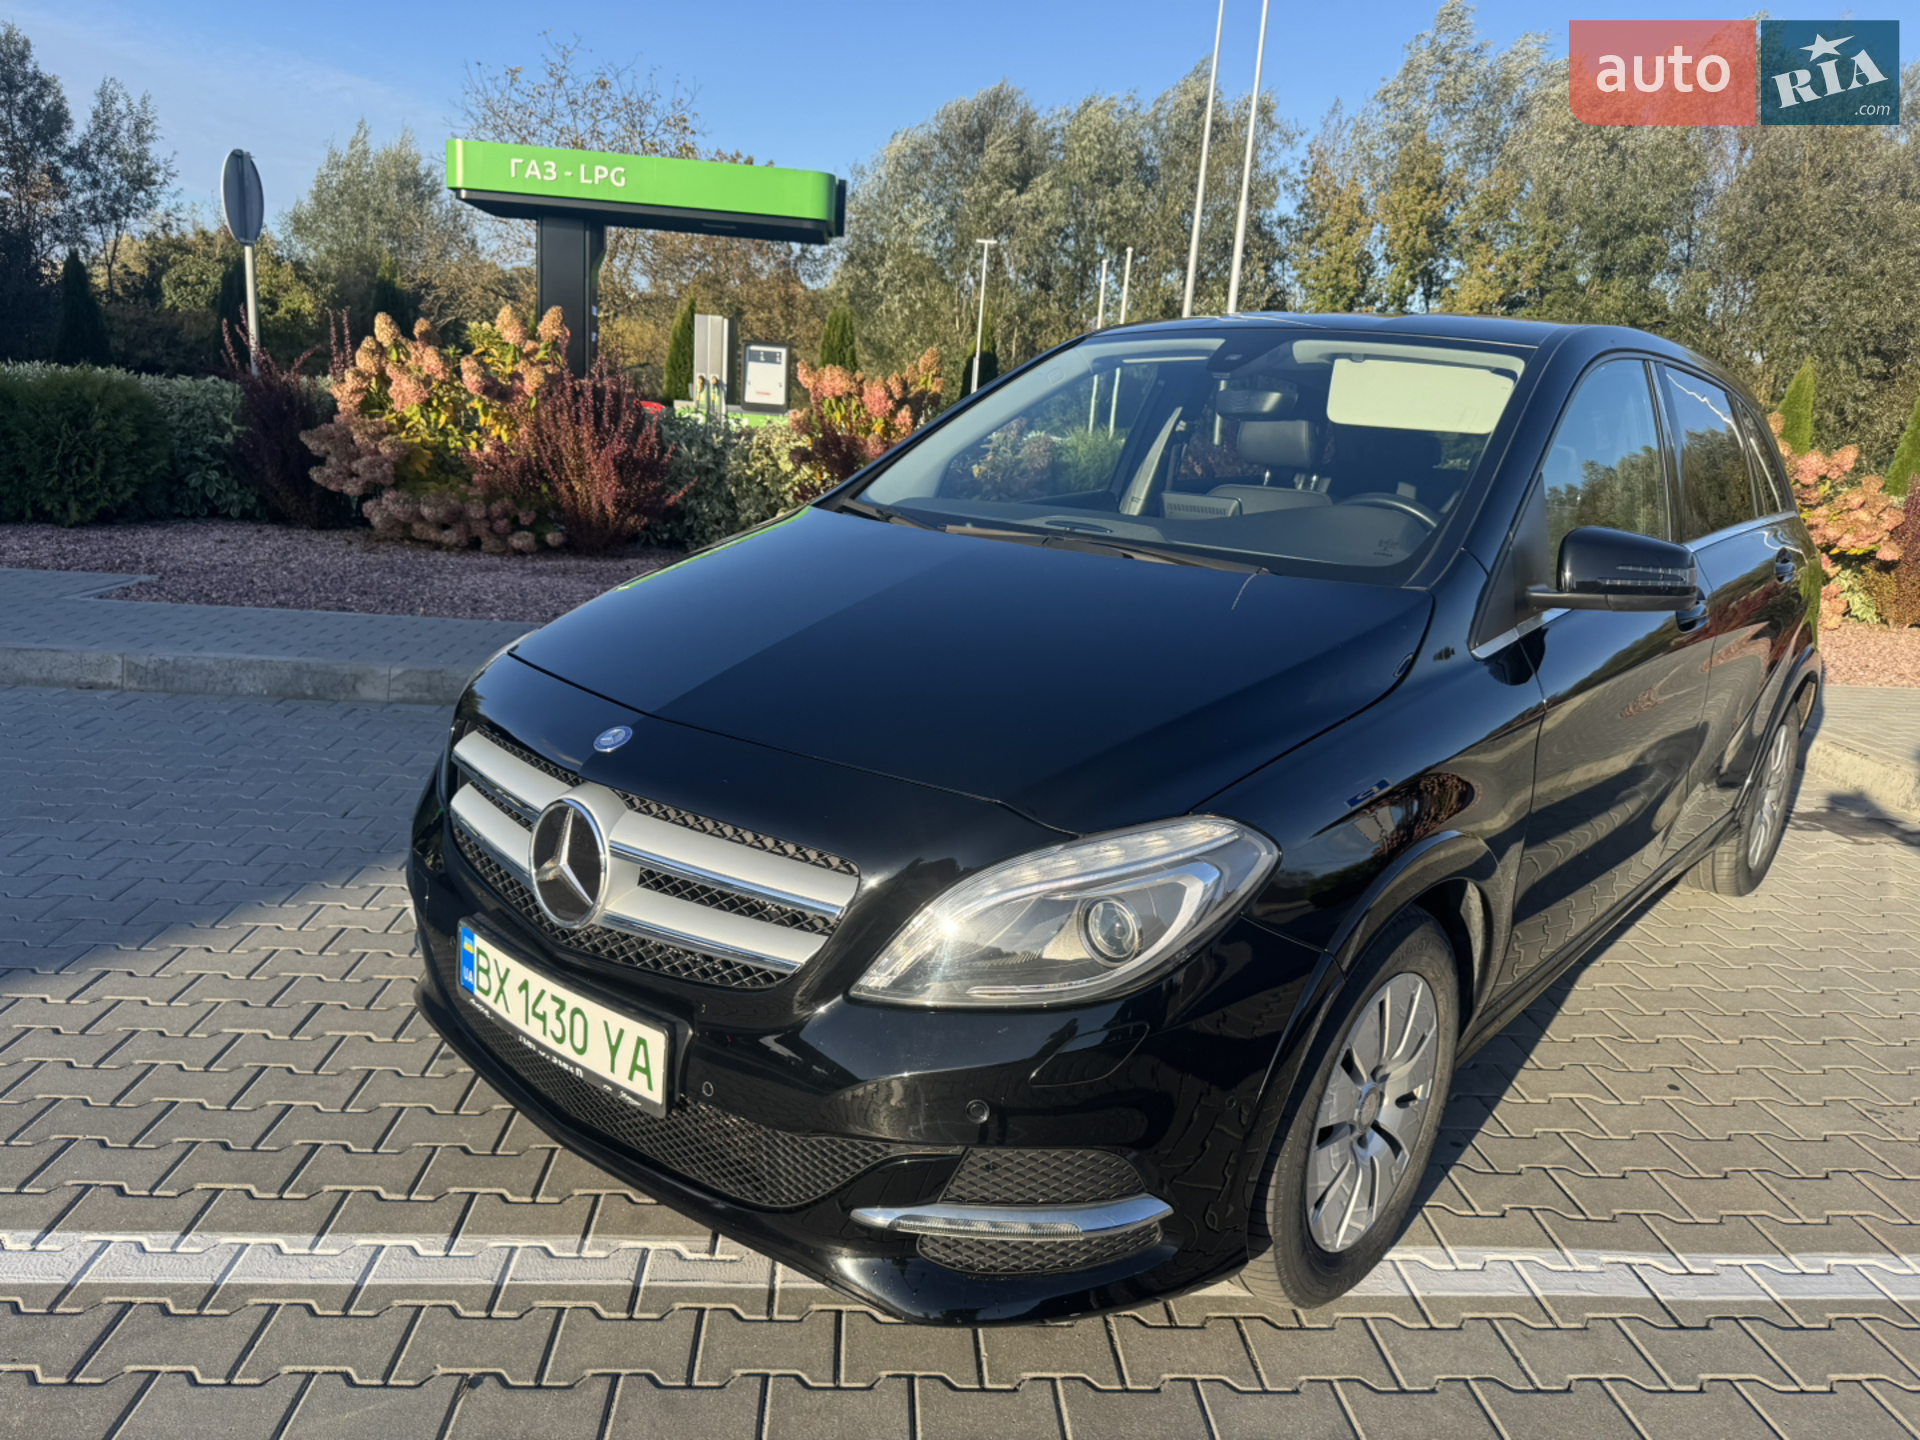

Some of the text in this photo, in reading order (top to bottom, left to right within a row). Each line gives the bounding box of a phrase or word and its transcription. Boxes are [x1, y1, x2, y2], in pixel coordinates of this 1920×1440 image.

[510, 158, 558, 181] ГАЗ
[580, 164, 627, 187] LPG
[476, 946, 511, 1014] BX
[517, 978, 588, 1056] 1430
[603, 1020, 654, 1092] YA
